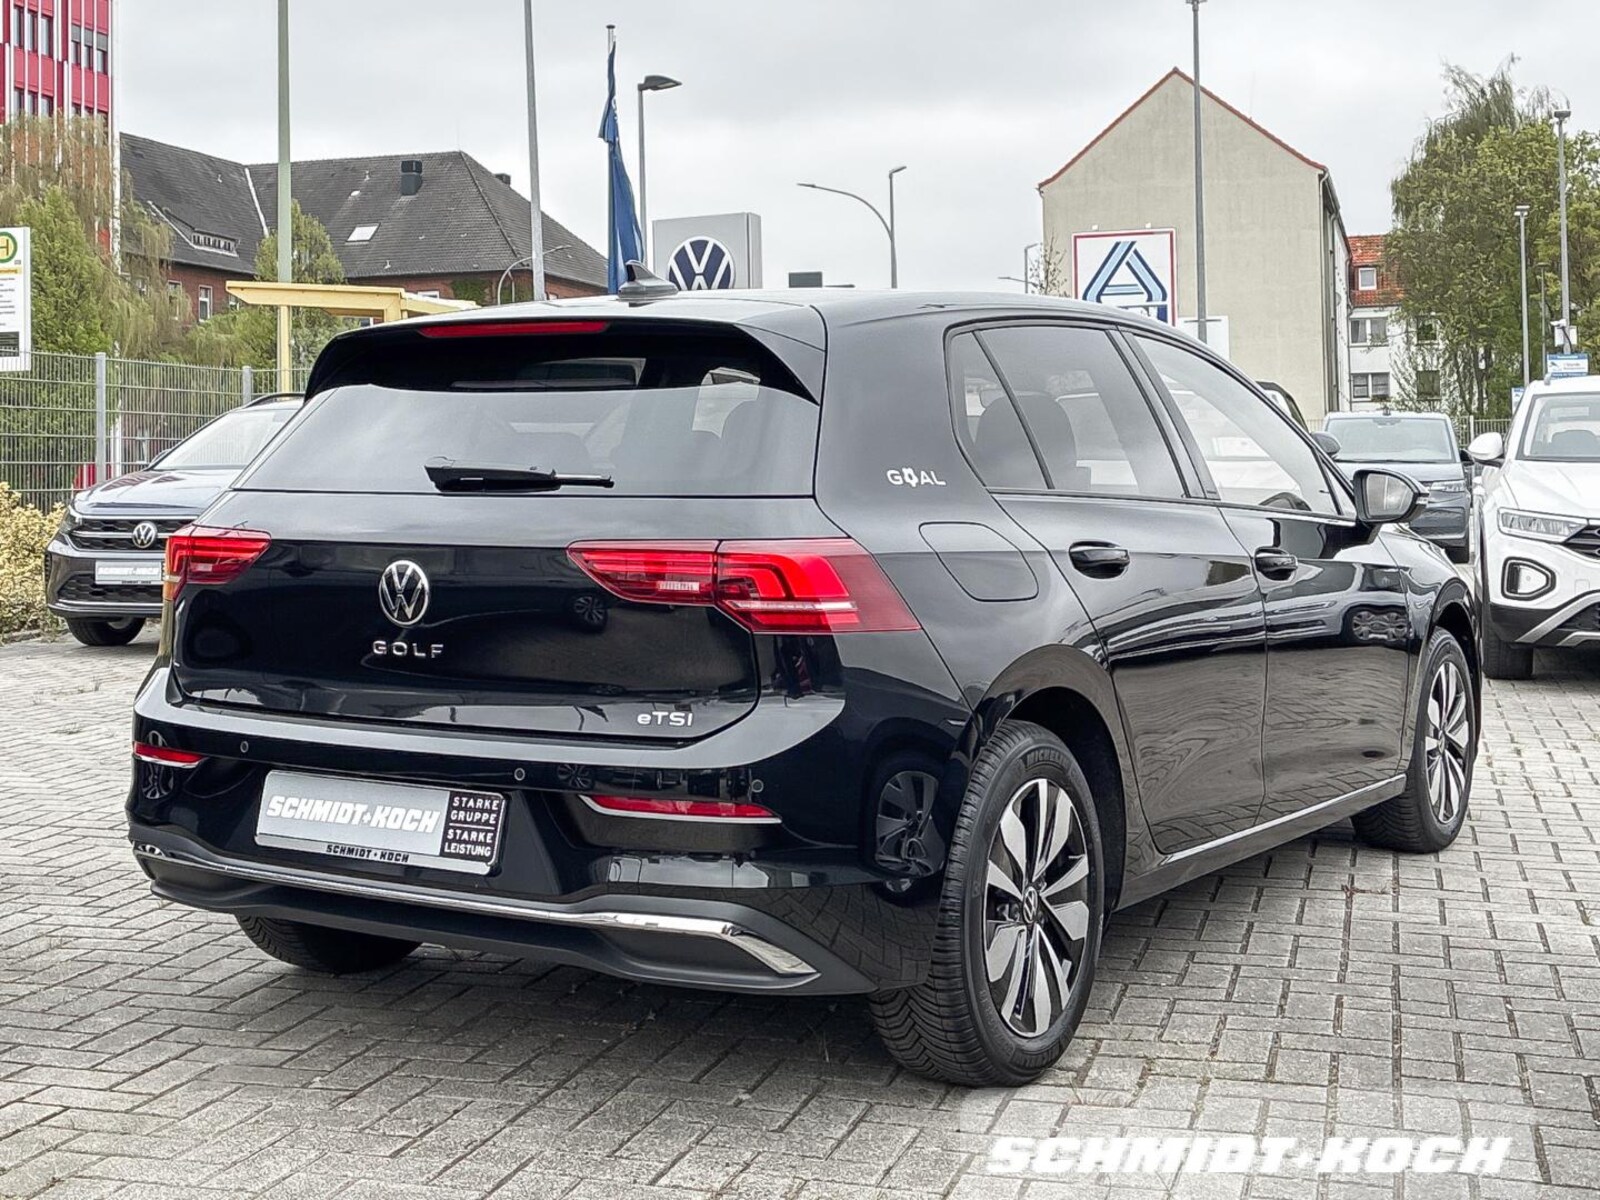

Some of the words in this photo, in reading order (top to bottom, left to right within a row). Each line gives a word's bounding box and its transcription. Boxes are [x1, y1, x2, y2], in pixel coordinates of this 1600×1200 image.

[886, 466, 946, 487] GOAL
[372, 640, 444, 659] GOLF
[637, 710, 694, 727] eTSI
[452, 796, 499, 811] STARKE
[450, 810, 497, 824] GRUPPE
[447, 828, 494, 843] STARKE
[444, 842, 491, 857] LEISTUNG
